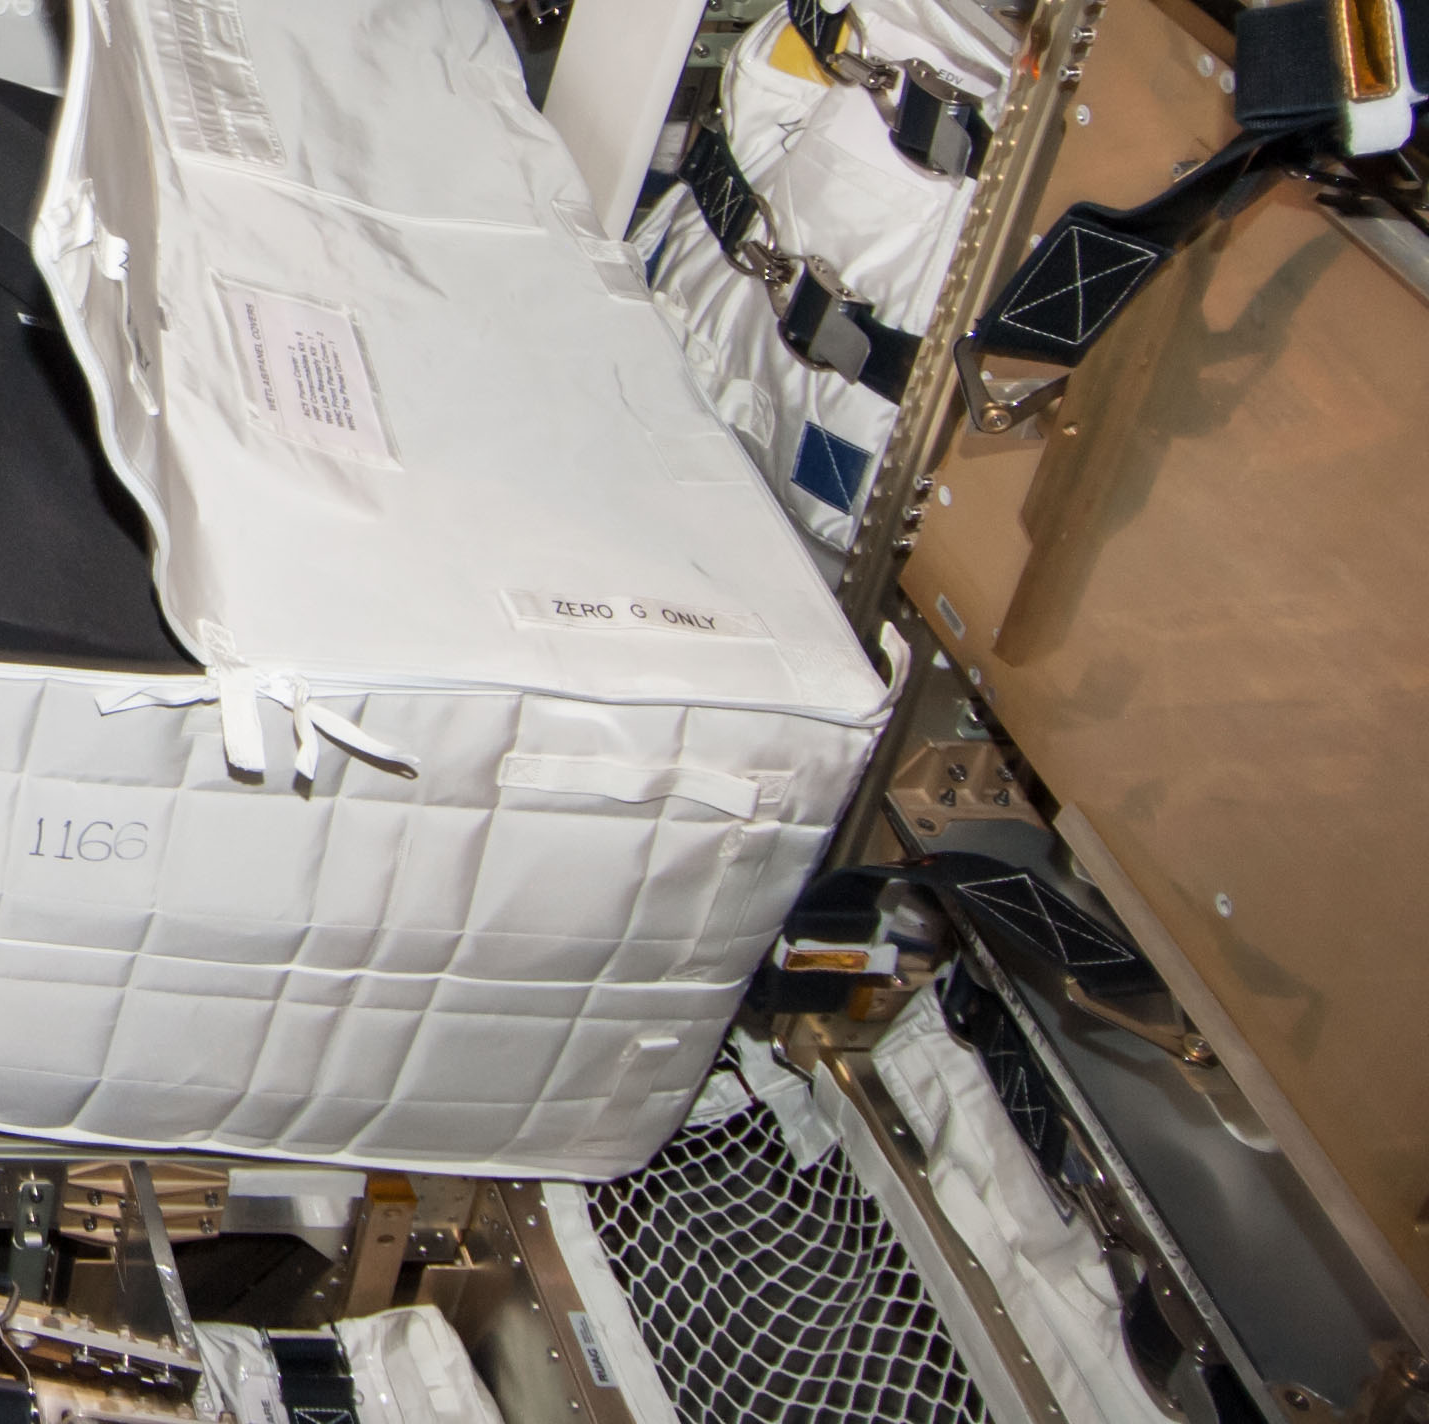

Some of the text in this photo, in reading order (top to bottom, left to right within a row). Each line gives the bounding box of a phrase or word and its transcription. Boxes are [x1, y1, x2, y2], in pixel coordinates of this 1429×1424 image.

[938, 69, 963, 84] EDV
[245, 303, 261, 340] COVERS
[551, 599, 716, 630] ZERO G ONLY
[29, 817, 149, 862] 1166
